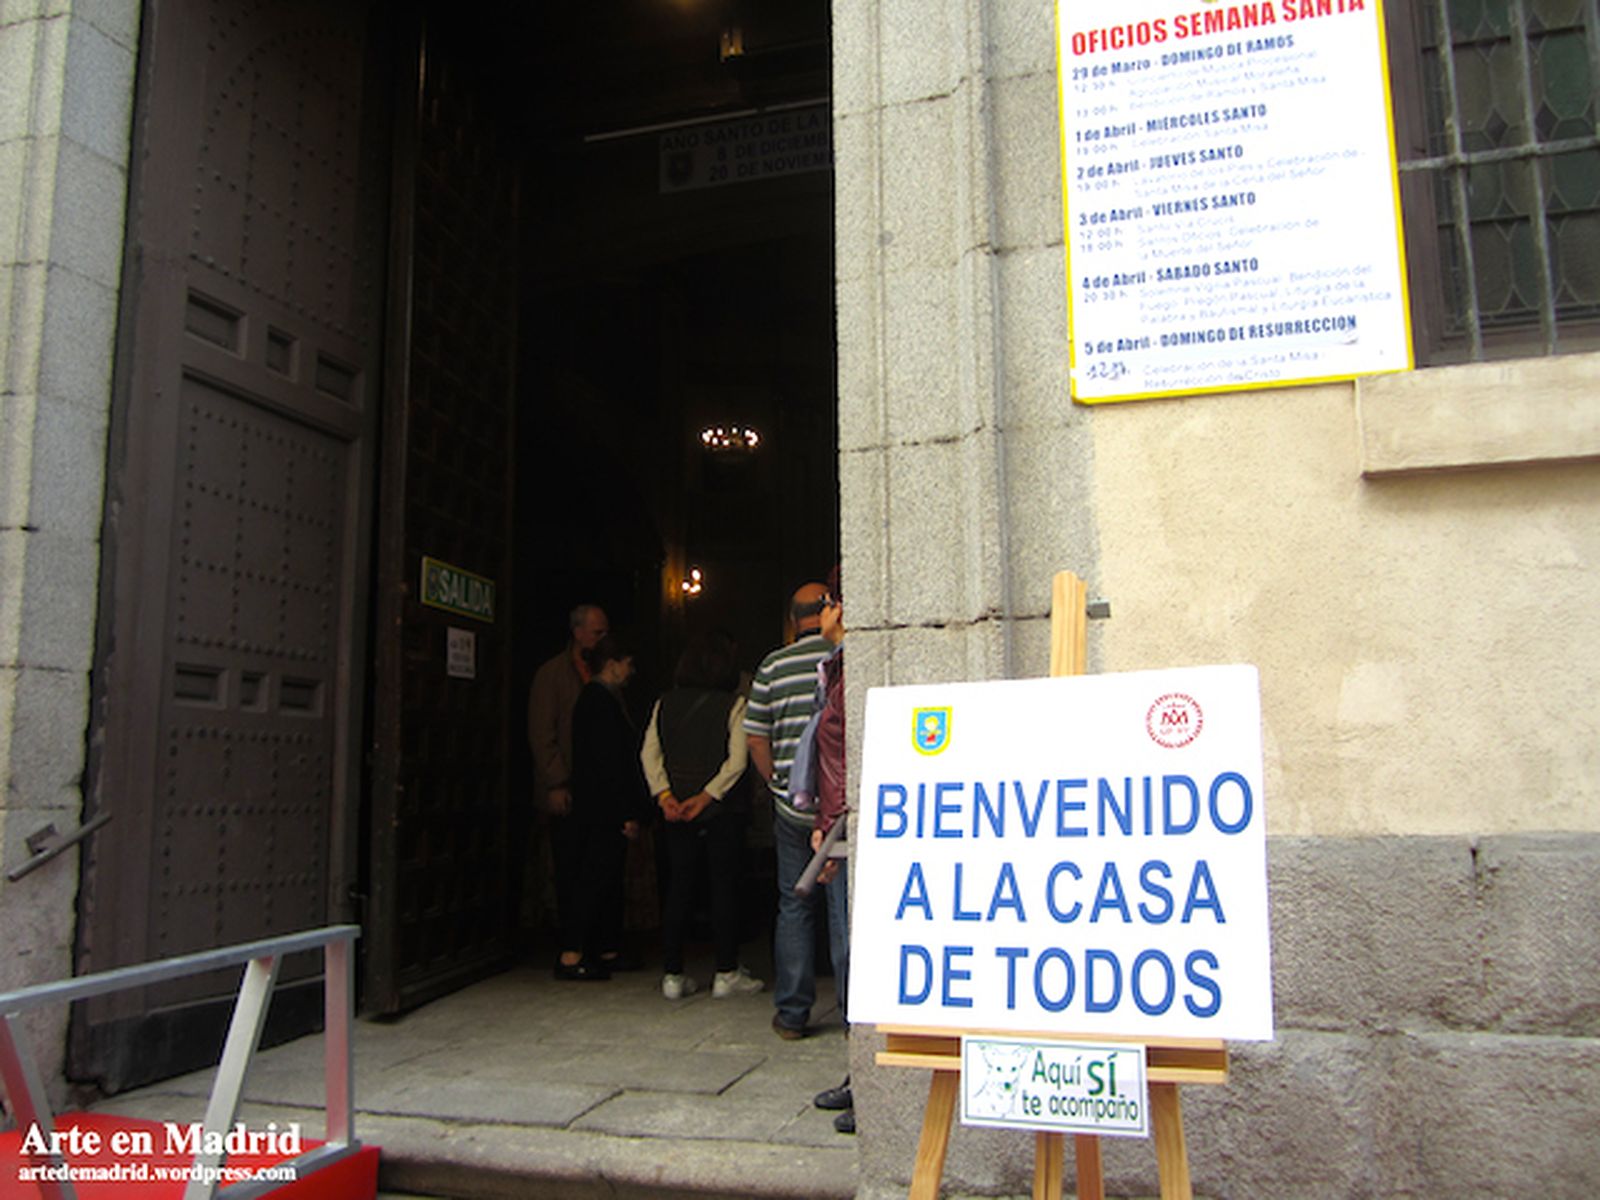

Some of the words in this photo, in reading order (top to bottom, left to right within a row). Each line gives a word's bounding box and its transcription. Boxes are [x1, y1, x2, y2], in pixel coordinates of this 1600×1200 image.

[1071, 18, 1168, 56] OFICIOS
[1173, 1, 1277, 40] SEMANA
[1091, 62, 1108, 78] de
[1110, 55, 1151, 75] Marzo
[1160, 44, 1224, 67] DOMINGO
[1226, 41, 1243, 57] DE
[1245, 33, 1295, 54] RAMOS
[704, 122, 763, 146] SANTO
[768, 117, 791, 134] DE
[797, 113, 819, 131] LA
[1075, 128, 1081, 143] 1
[1084, 125, 1100, 142] de
[1103, 120, 1136, 140] Abril
[1221, 101, 1268, 123] SANTO
[738, 161, 760, 177] DE
[1076, 165, 1084, 180] 2
[1086, 162, 1104, 178] de
[1106, 157, 1140, 176] Abril
[1148, 150, 1196, 170] JUEVES
[1198, 143, 1244, 164] SANTO
[1078, 211, 1087, 226] 3
[1089, 209, 1107, 225] de
[1109, 204, 1143, 223] Abril
[1151, 196, 1208, 217] VIERNES
[1210, 190, 1256, 210] SANTO
[1081, 275, 1090, 290] 4
[1091, 273, 1109, 289] de
[1112, 269, 1146, 287] Abril
[1155, 262, 1211, 282] SABADO
[1213, 256, 1259, 276] SANTO
[1084, 340, 1093, 355] 5
[1096, 338, 1113, 354] de
[1116, 334, 1150, 352] Abril
[1159, 327, 1226, 348] DOMINGO
[1227, 325, 1245, 341] DE
[439, 569, 495, 616] SALIDA
[875, 771, 1254, 839] BIENVENIDO
[895, 862, 933, 921] A
[952, 861, 1027, 922] LA
[1045, 859, 1227, 924] CASA
[897, 943, 974, 1008] DE
[995, 946, 1223, 1019] TODOS
[1031, 1050, 1083, 1090] Aquí
[1022, 1090, 1042, 1116] te
[1049, 1093, 1139, 1124] acompaño
